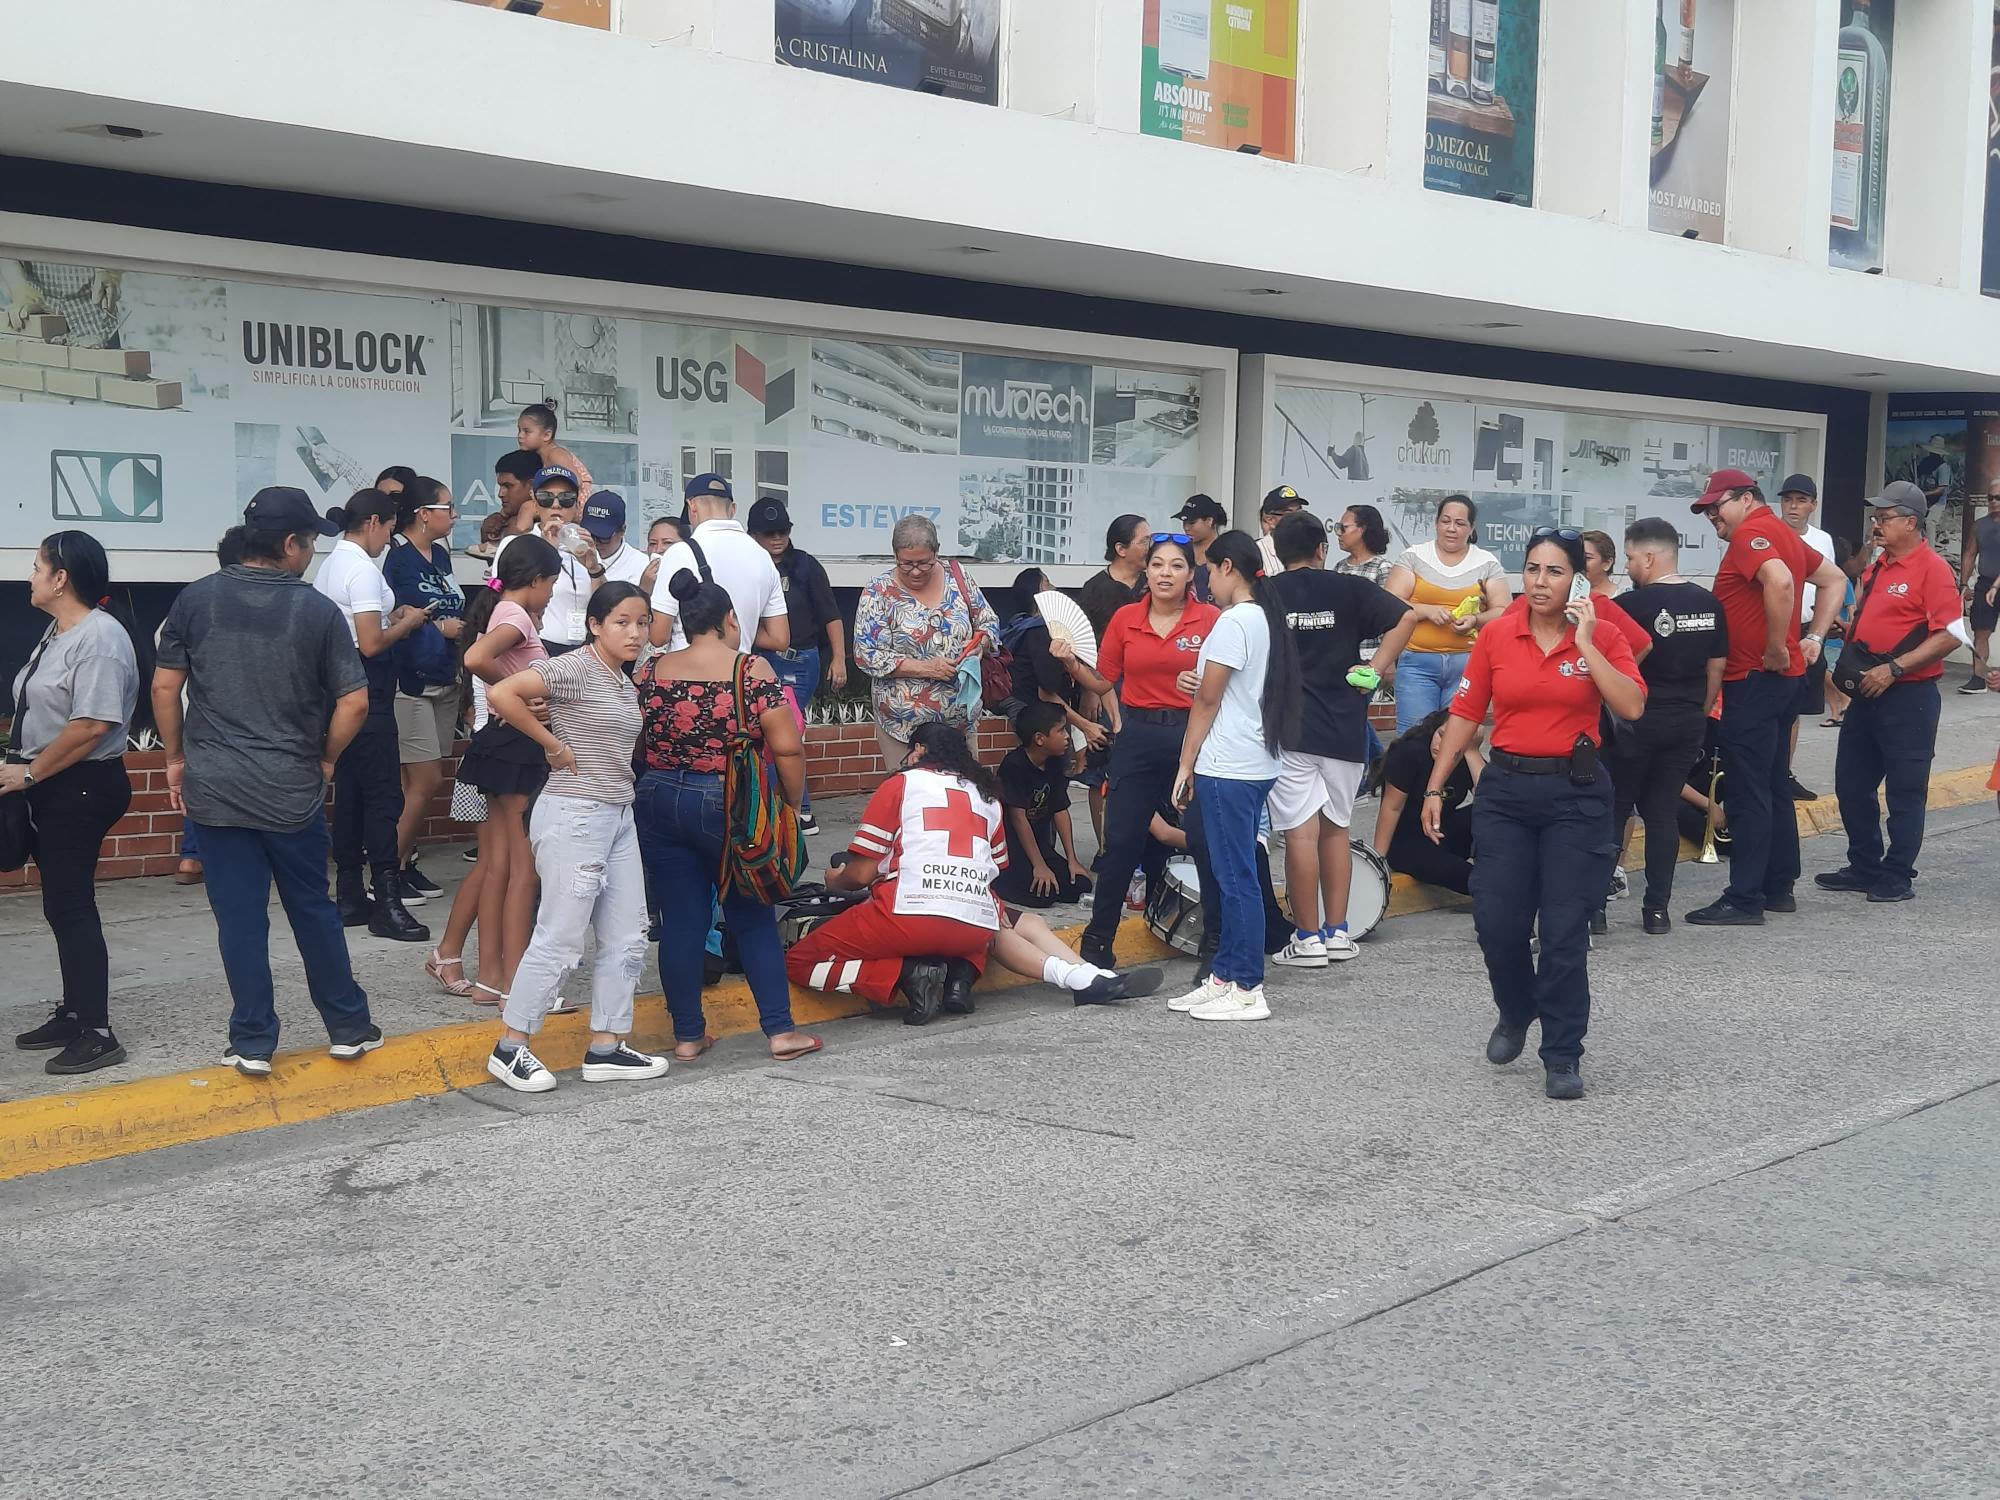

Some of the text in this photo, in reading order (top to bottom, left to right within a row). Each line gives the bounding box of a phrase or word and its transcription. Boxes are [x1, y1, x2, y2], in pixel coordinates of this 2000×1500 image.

[789, 38, 888, 74] CRISTALINA
[1170, 107, 1177, 119] IN
[1188, 111, 1206, 125] SPIRIT
[1437, 134, 1492, 163] MEZCAL
[1444, 158, 1456, 169] EN
[1456, 160, 1489, 177] OAXACA
[1649, 188, 1676, 207] MOST
[1678, 195, 1721, 217] AWARDED
[243, 320, 427, 376] UNIBLOCK
[253, 371, 421, 394] SIMPLIFICA LA CONSTRUCCION
[656, 356, 728, 403] USG
[983, 425, 991, 434] LA
[1398, 440, 1451, 465] chukum
[1728, 448, 1780, 469] BRAVAT
[922, 863, 989, 884] CRUZ ROJA
[922, 878, 989, 898] MEXICANA
